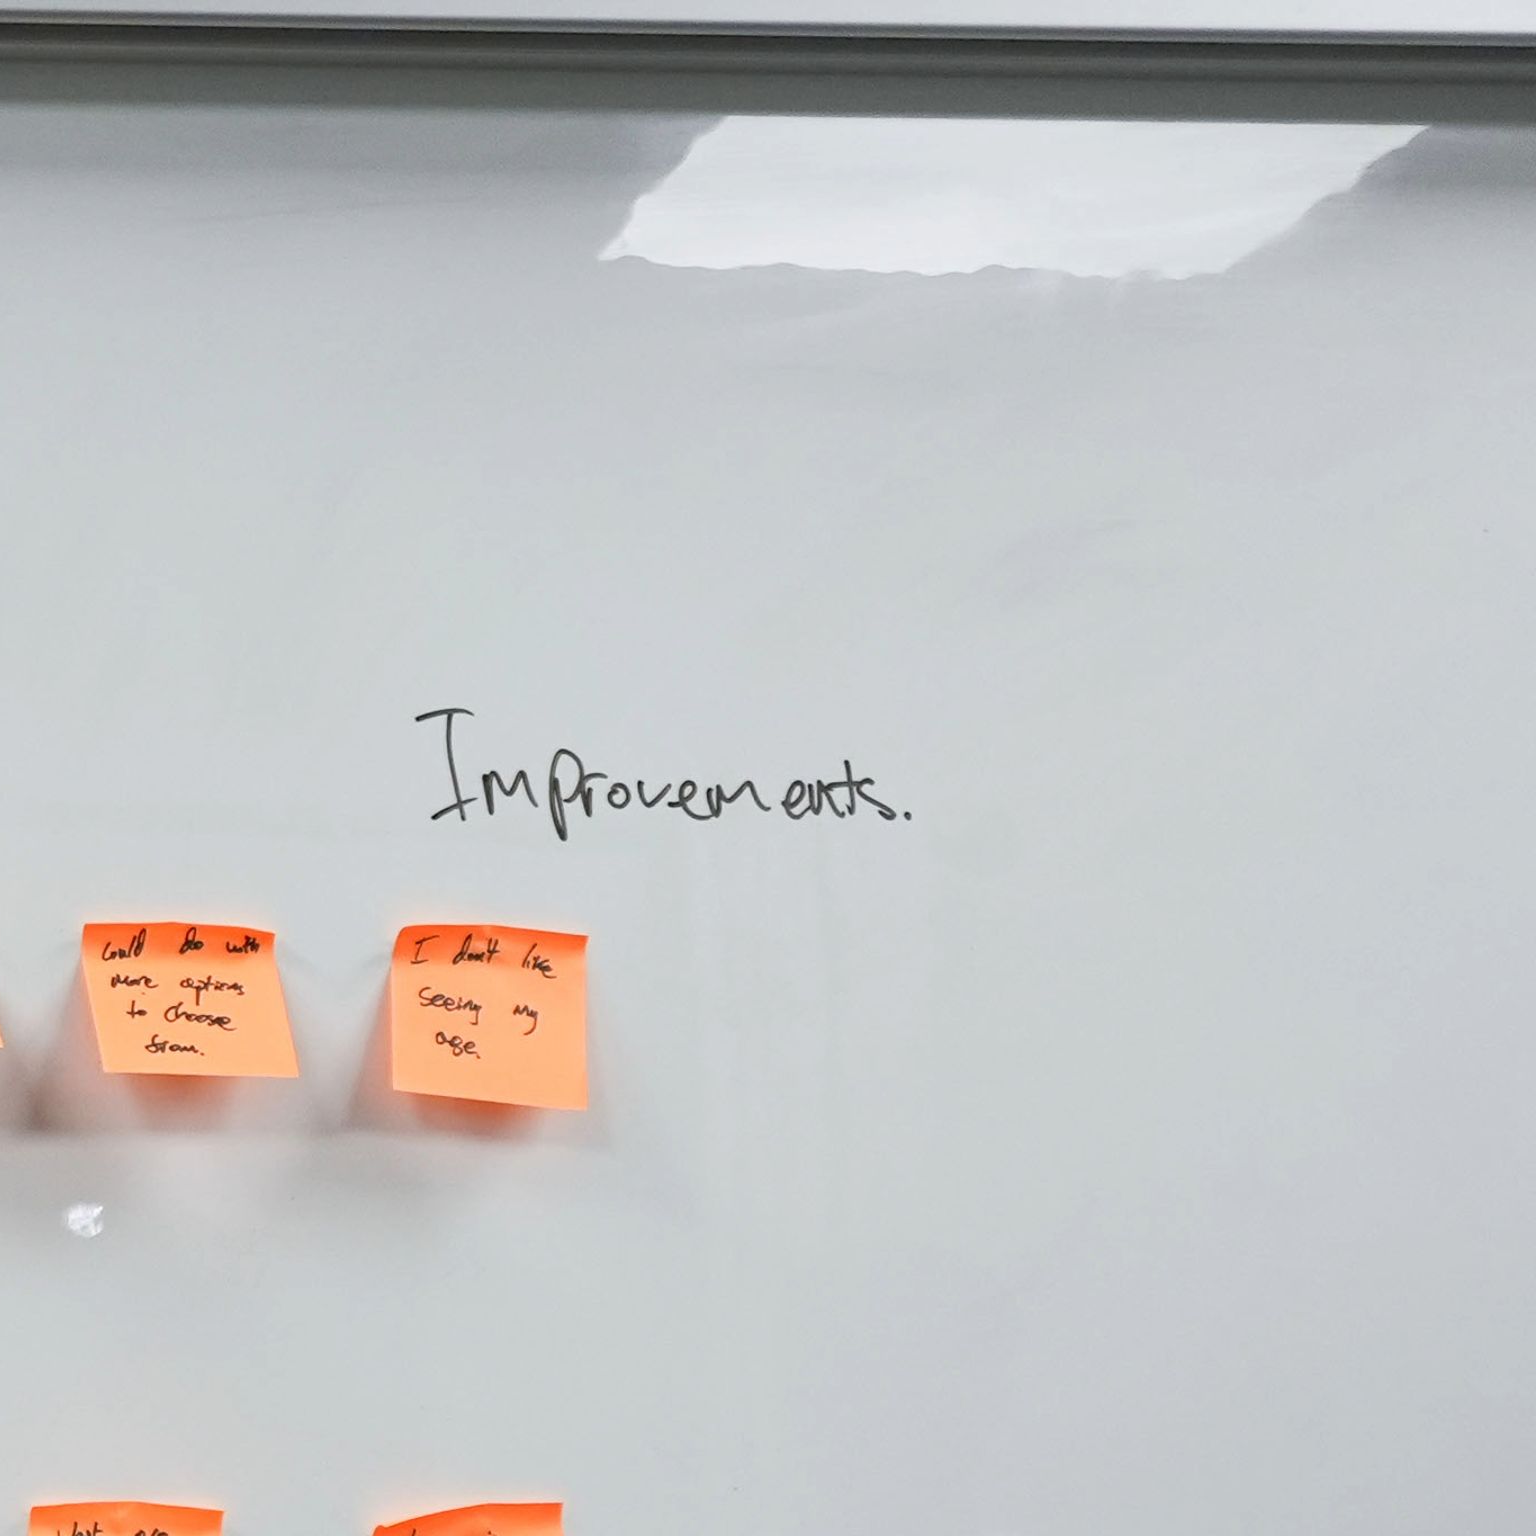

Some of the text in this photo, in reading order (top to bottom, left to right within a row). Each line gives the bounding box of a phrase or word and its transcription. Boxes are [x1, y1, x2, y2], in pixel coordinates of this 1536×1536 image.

[415, 708, 912, 841] Improvements.
[411, 935, 440, 964] I
[522, 943, 557, 978] like
[127, 1001, 148, 1018] to
